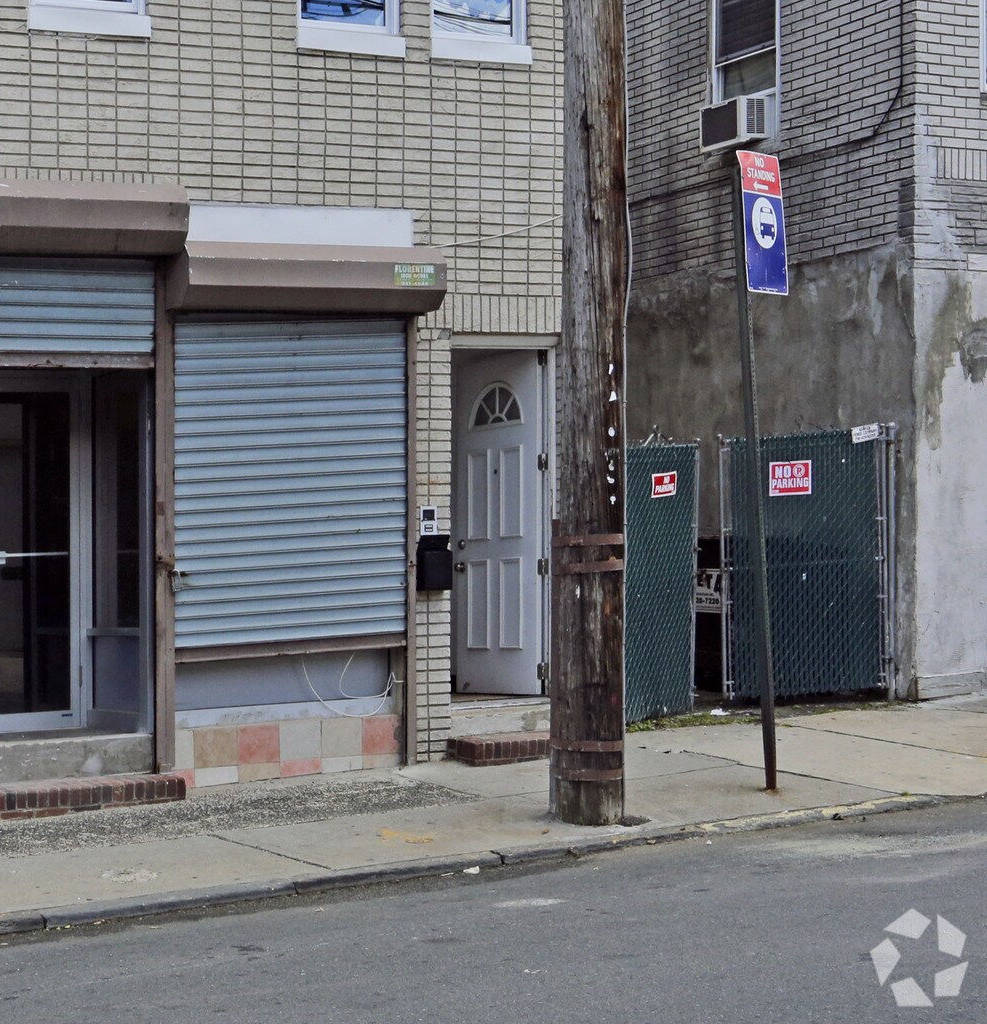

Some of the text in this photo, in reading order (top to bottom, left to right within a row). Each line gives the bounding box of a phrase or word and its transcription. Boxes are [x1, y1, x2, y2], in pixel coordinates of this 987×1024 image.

[754, 157, 764, 168] NO
[747, 167, 776, 183] STANDING
[774, 465, 792, 478] NO
[655, 484, 674, 493] PARKING
[772, 478, 809, 488] PARKING
